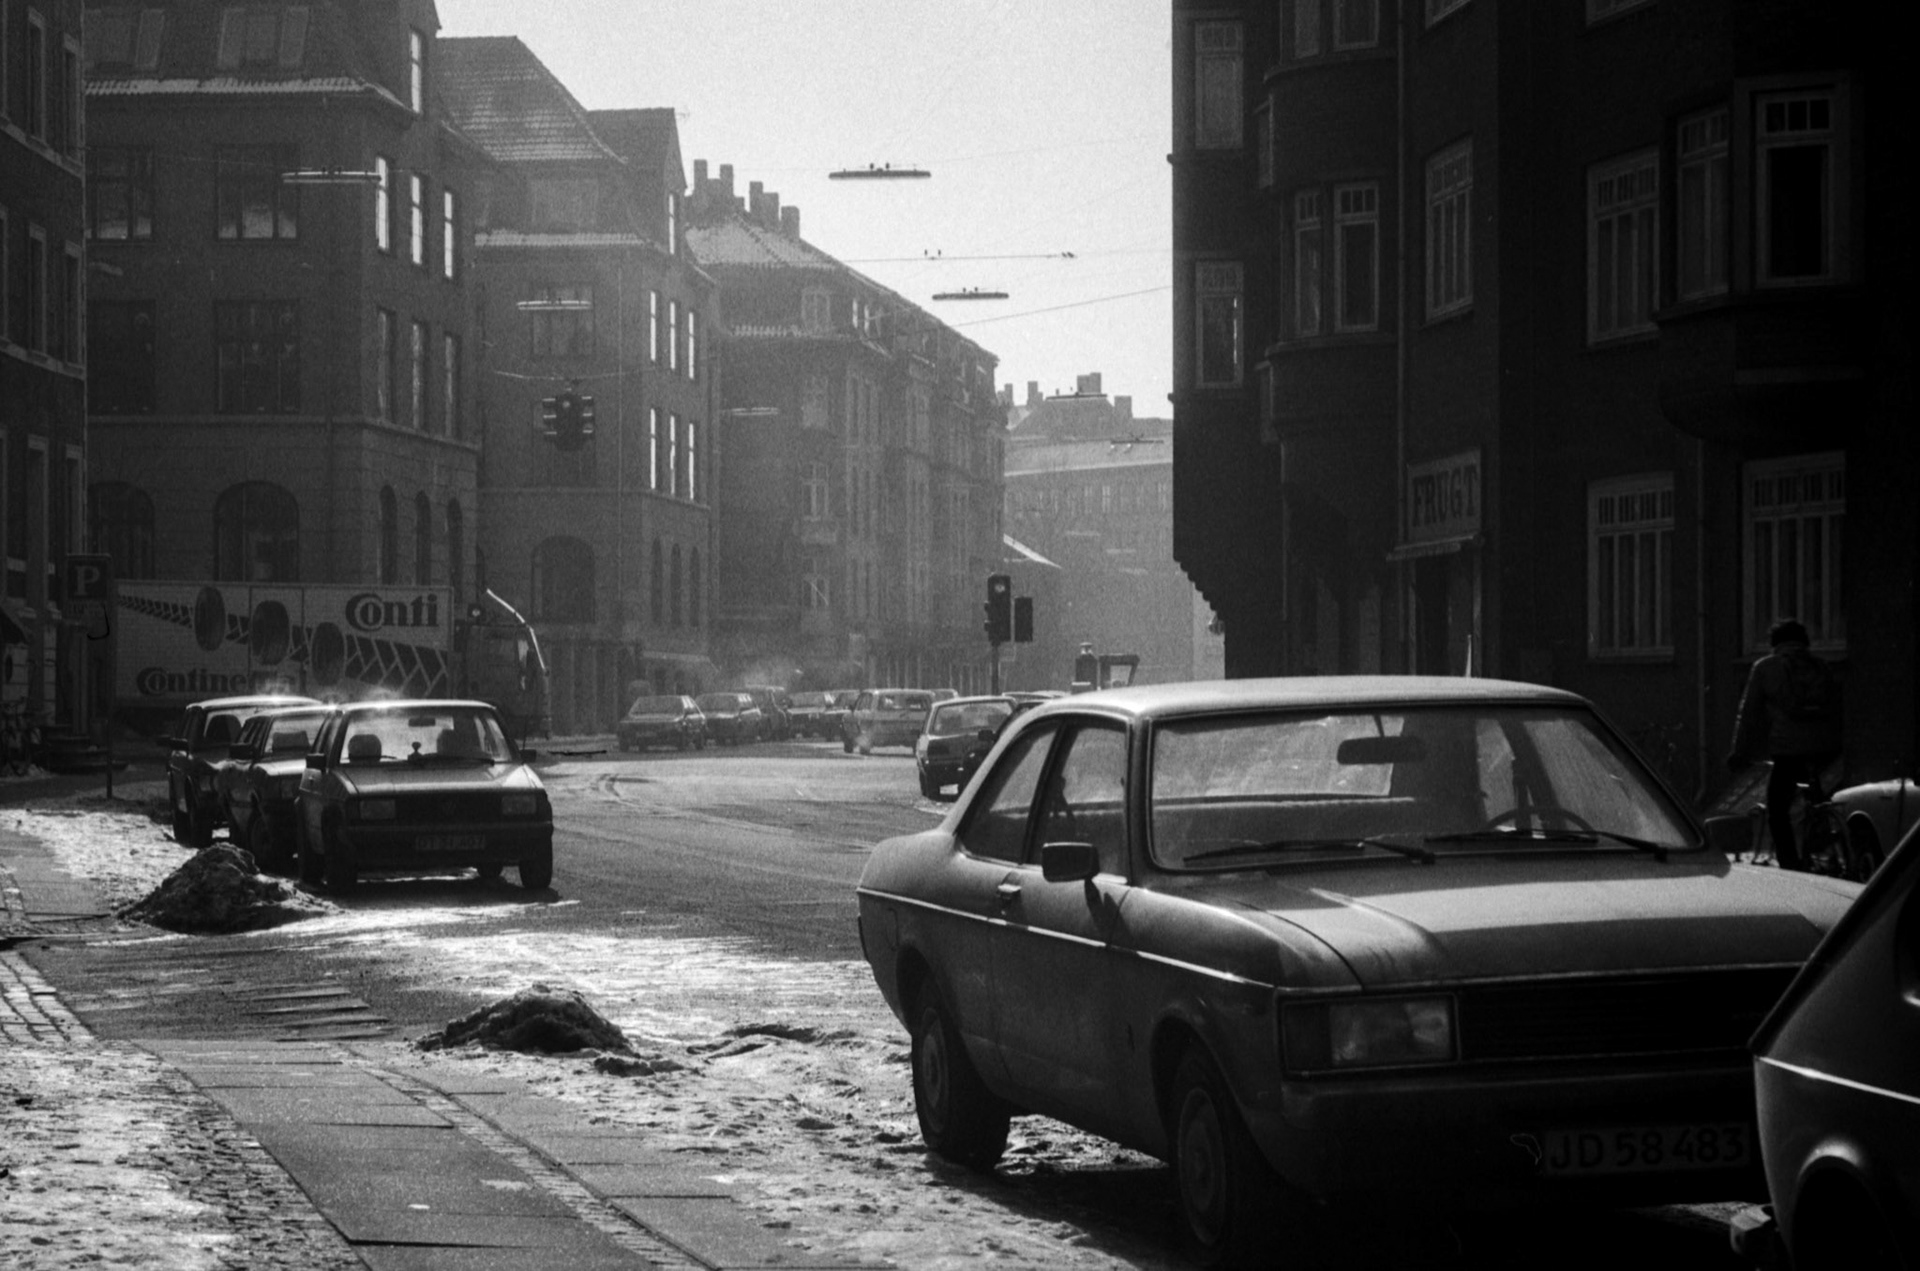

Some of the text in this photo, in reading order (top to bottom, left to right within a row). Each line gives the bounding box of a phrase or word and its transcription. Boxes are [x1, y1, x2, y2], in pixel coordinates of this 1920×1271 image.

[1412, 464, 1478, 528] FRUGT
[74, 565, 100, 596] P
[345, 592, 439, 632] Conti
[1550, 1126, 1744, 1169] JD 58 483
